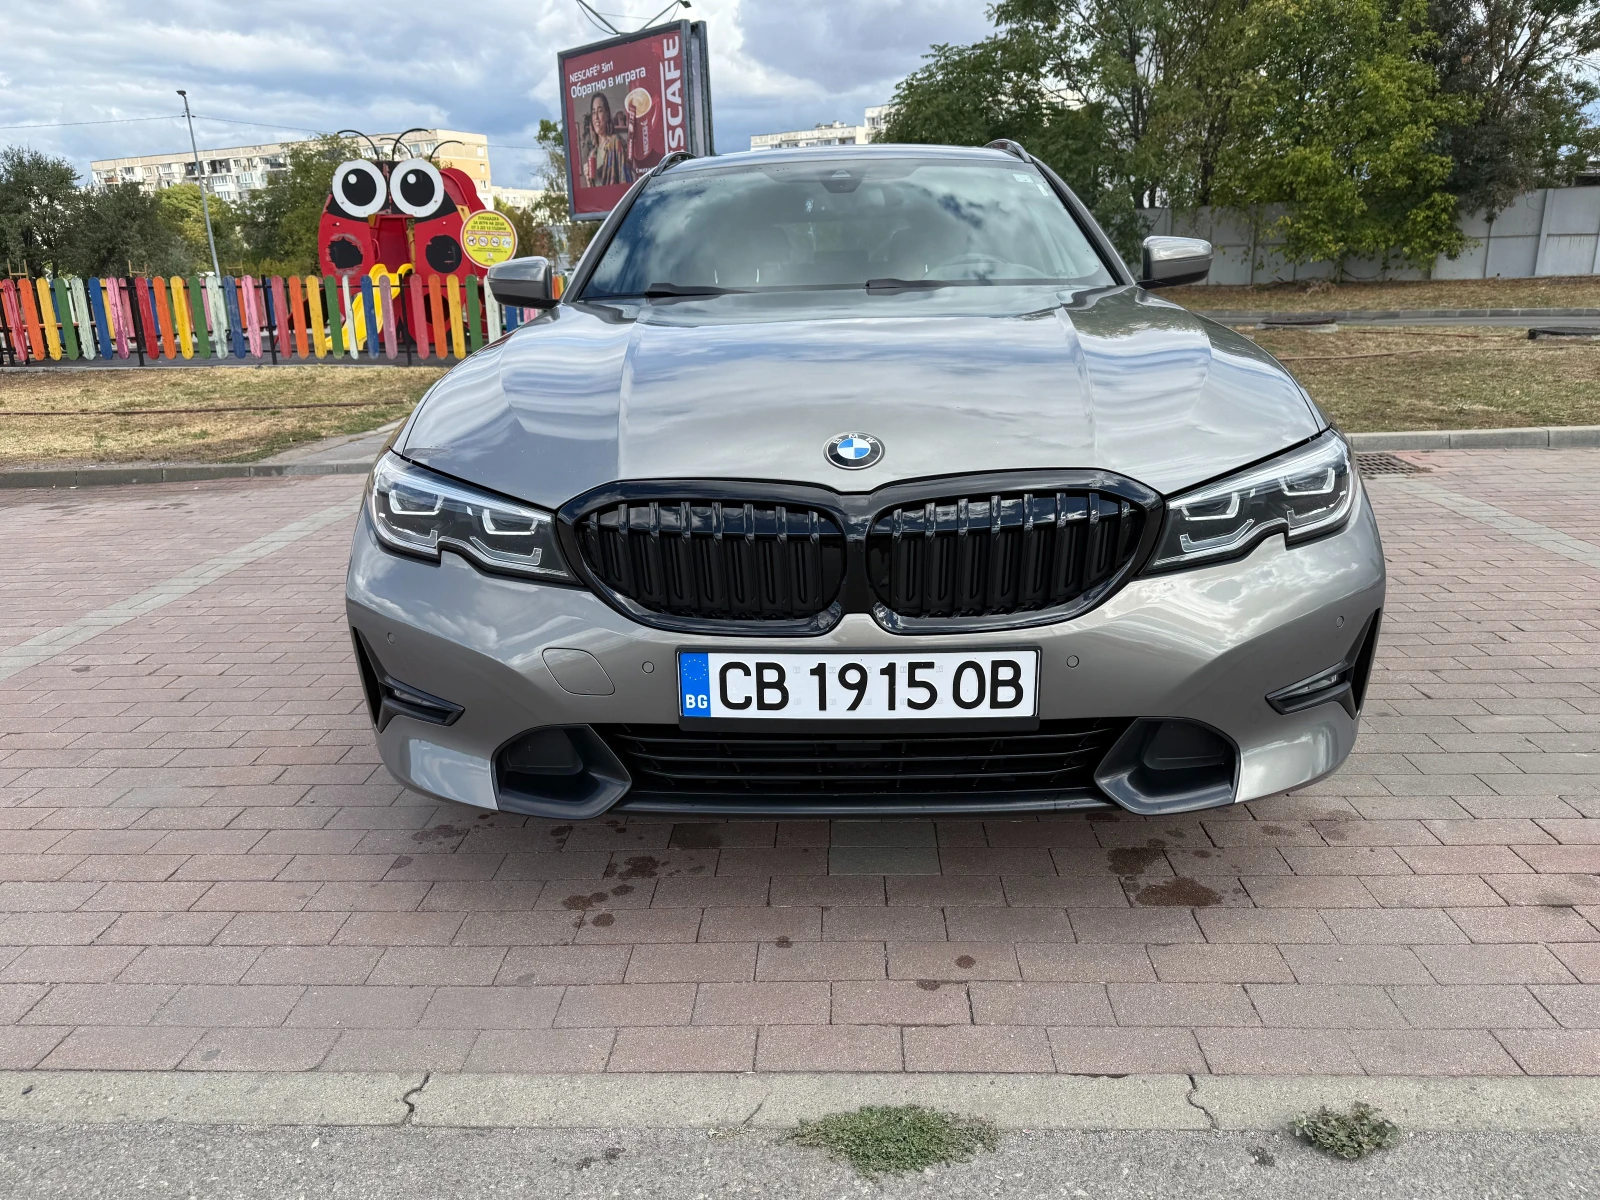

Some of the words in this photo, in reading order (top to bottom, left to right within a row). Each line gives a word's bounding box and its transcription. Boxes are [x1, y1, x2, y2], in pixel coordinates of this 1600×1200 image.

[601, 60, 614, 74] 3in1
[570, 79, 607, 98] Обратно
[607, 76, 614, 88] в
[615, 67, 646, 85] играта
[718, 661, 790, 711] CB
[809, 661, 938, 711] 1915
[952, 659, 1024, 710] OB
[685, 694, 708, 709] BG
